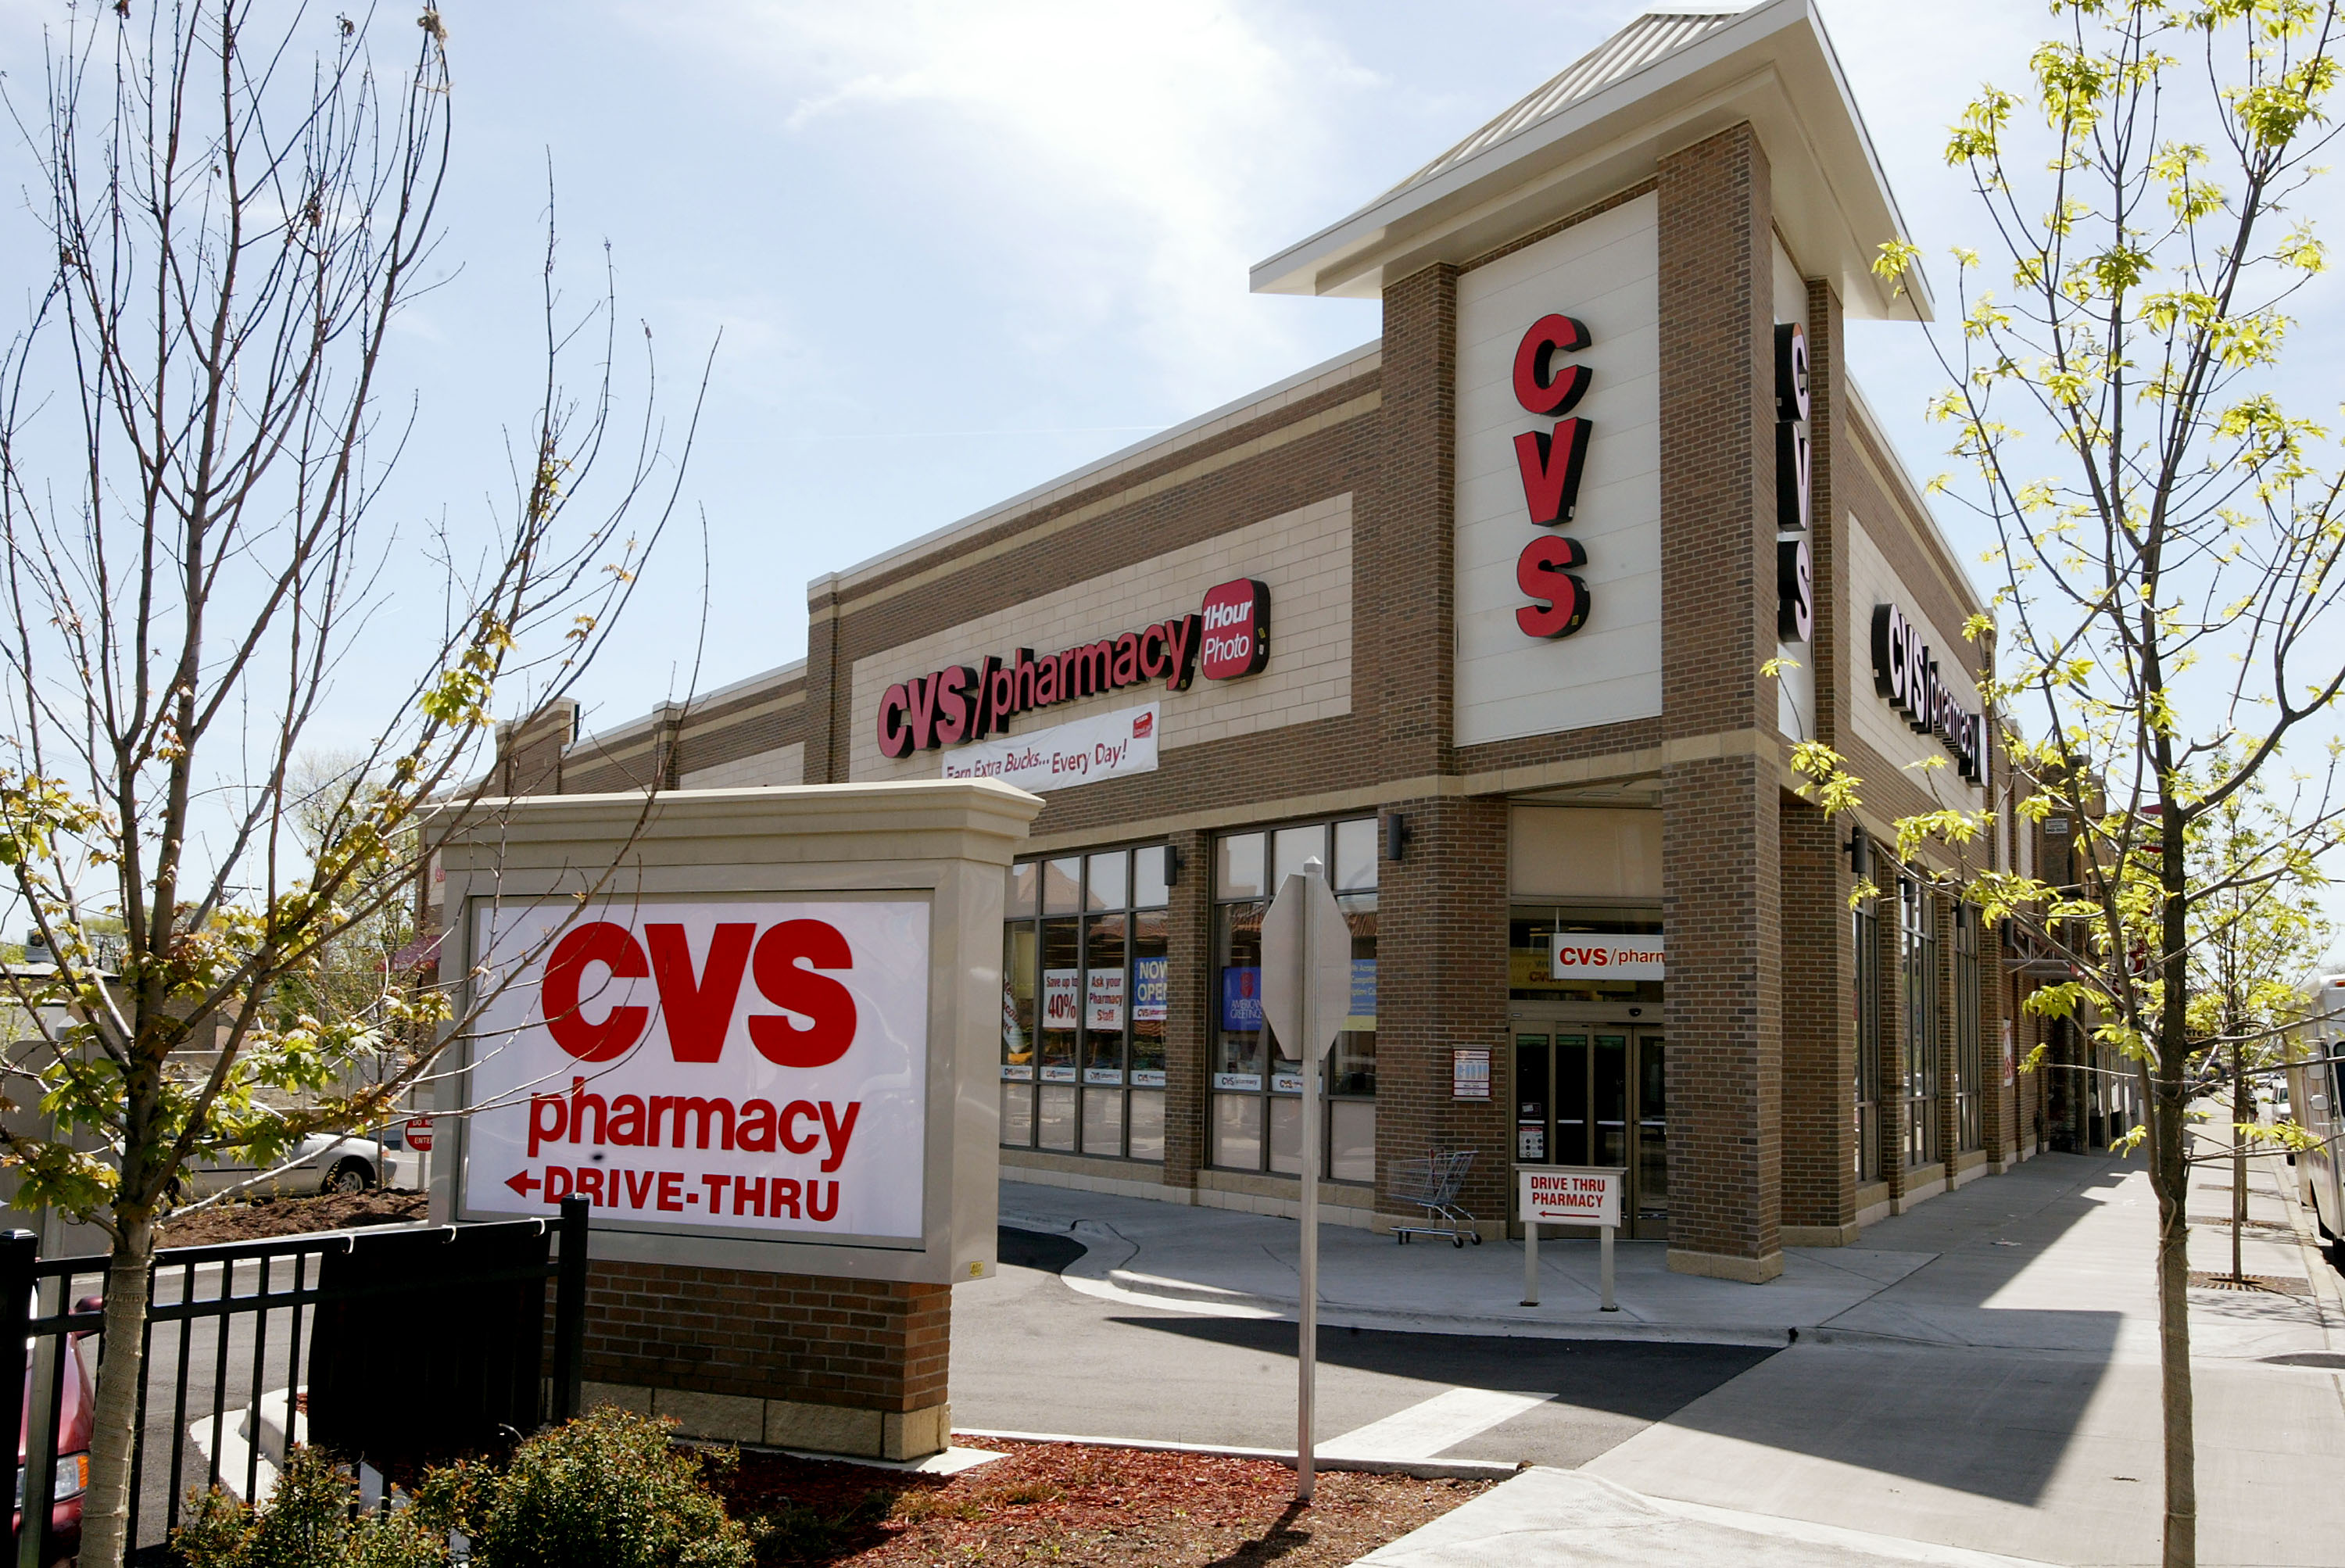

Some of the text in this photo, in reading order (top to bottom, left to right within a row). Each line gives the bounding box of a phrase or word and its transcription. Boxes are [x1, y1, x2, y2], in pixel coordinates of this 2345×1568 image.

[1513, 313, 1579, 637] CVS
[1204, 633, 1249, 665] Photo
[947, 766, 971, 778] Earn
[975, 760, 1001, 777] Extra
[1052, 752, 1090, 775] Every
[1095, 738, 1127, 768] Day!
[1559, 947, 1664, 966] CVS/pharm
[542, 918, 857, 1068] CVS
[1048, 993, 1076, 1018] 40%
[527, 1076, 861, 1172] pharmacy
[543, 1165, 840, 1223] DRIVE-THRU
[1531, 1176, 1605, 1192] DRIVE THRU
[1533, 1192, 1603, 1208] PHARMACY
